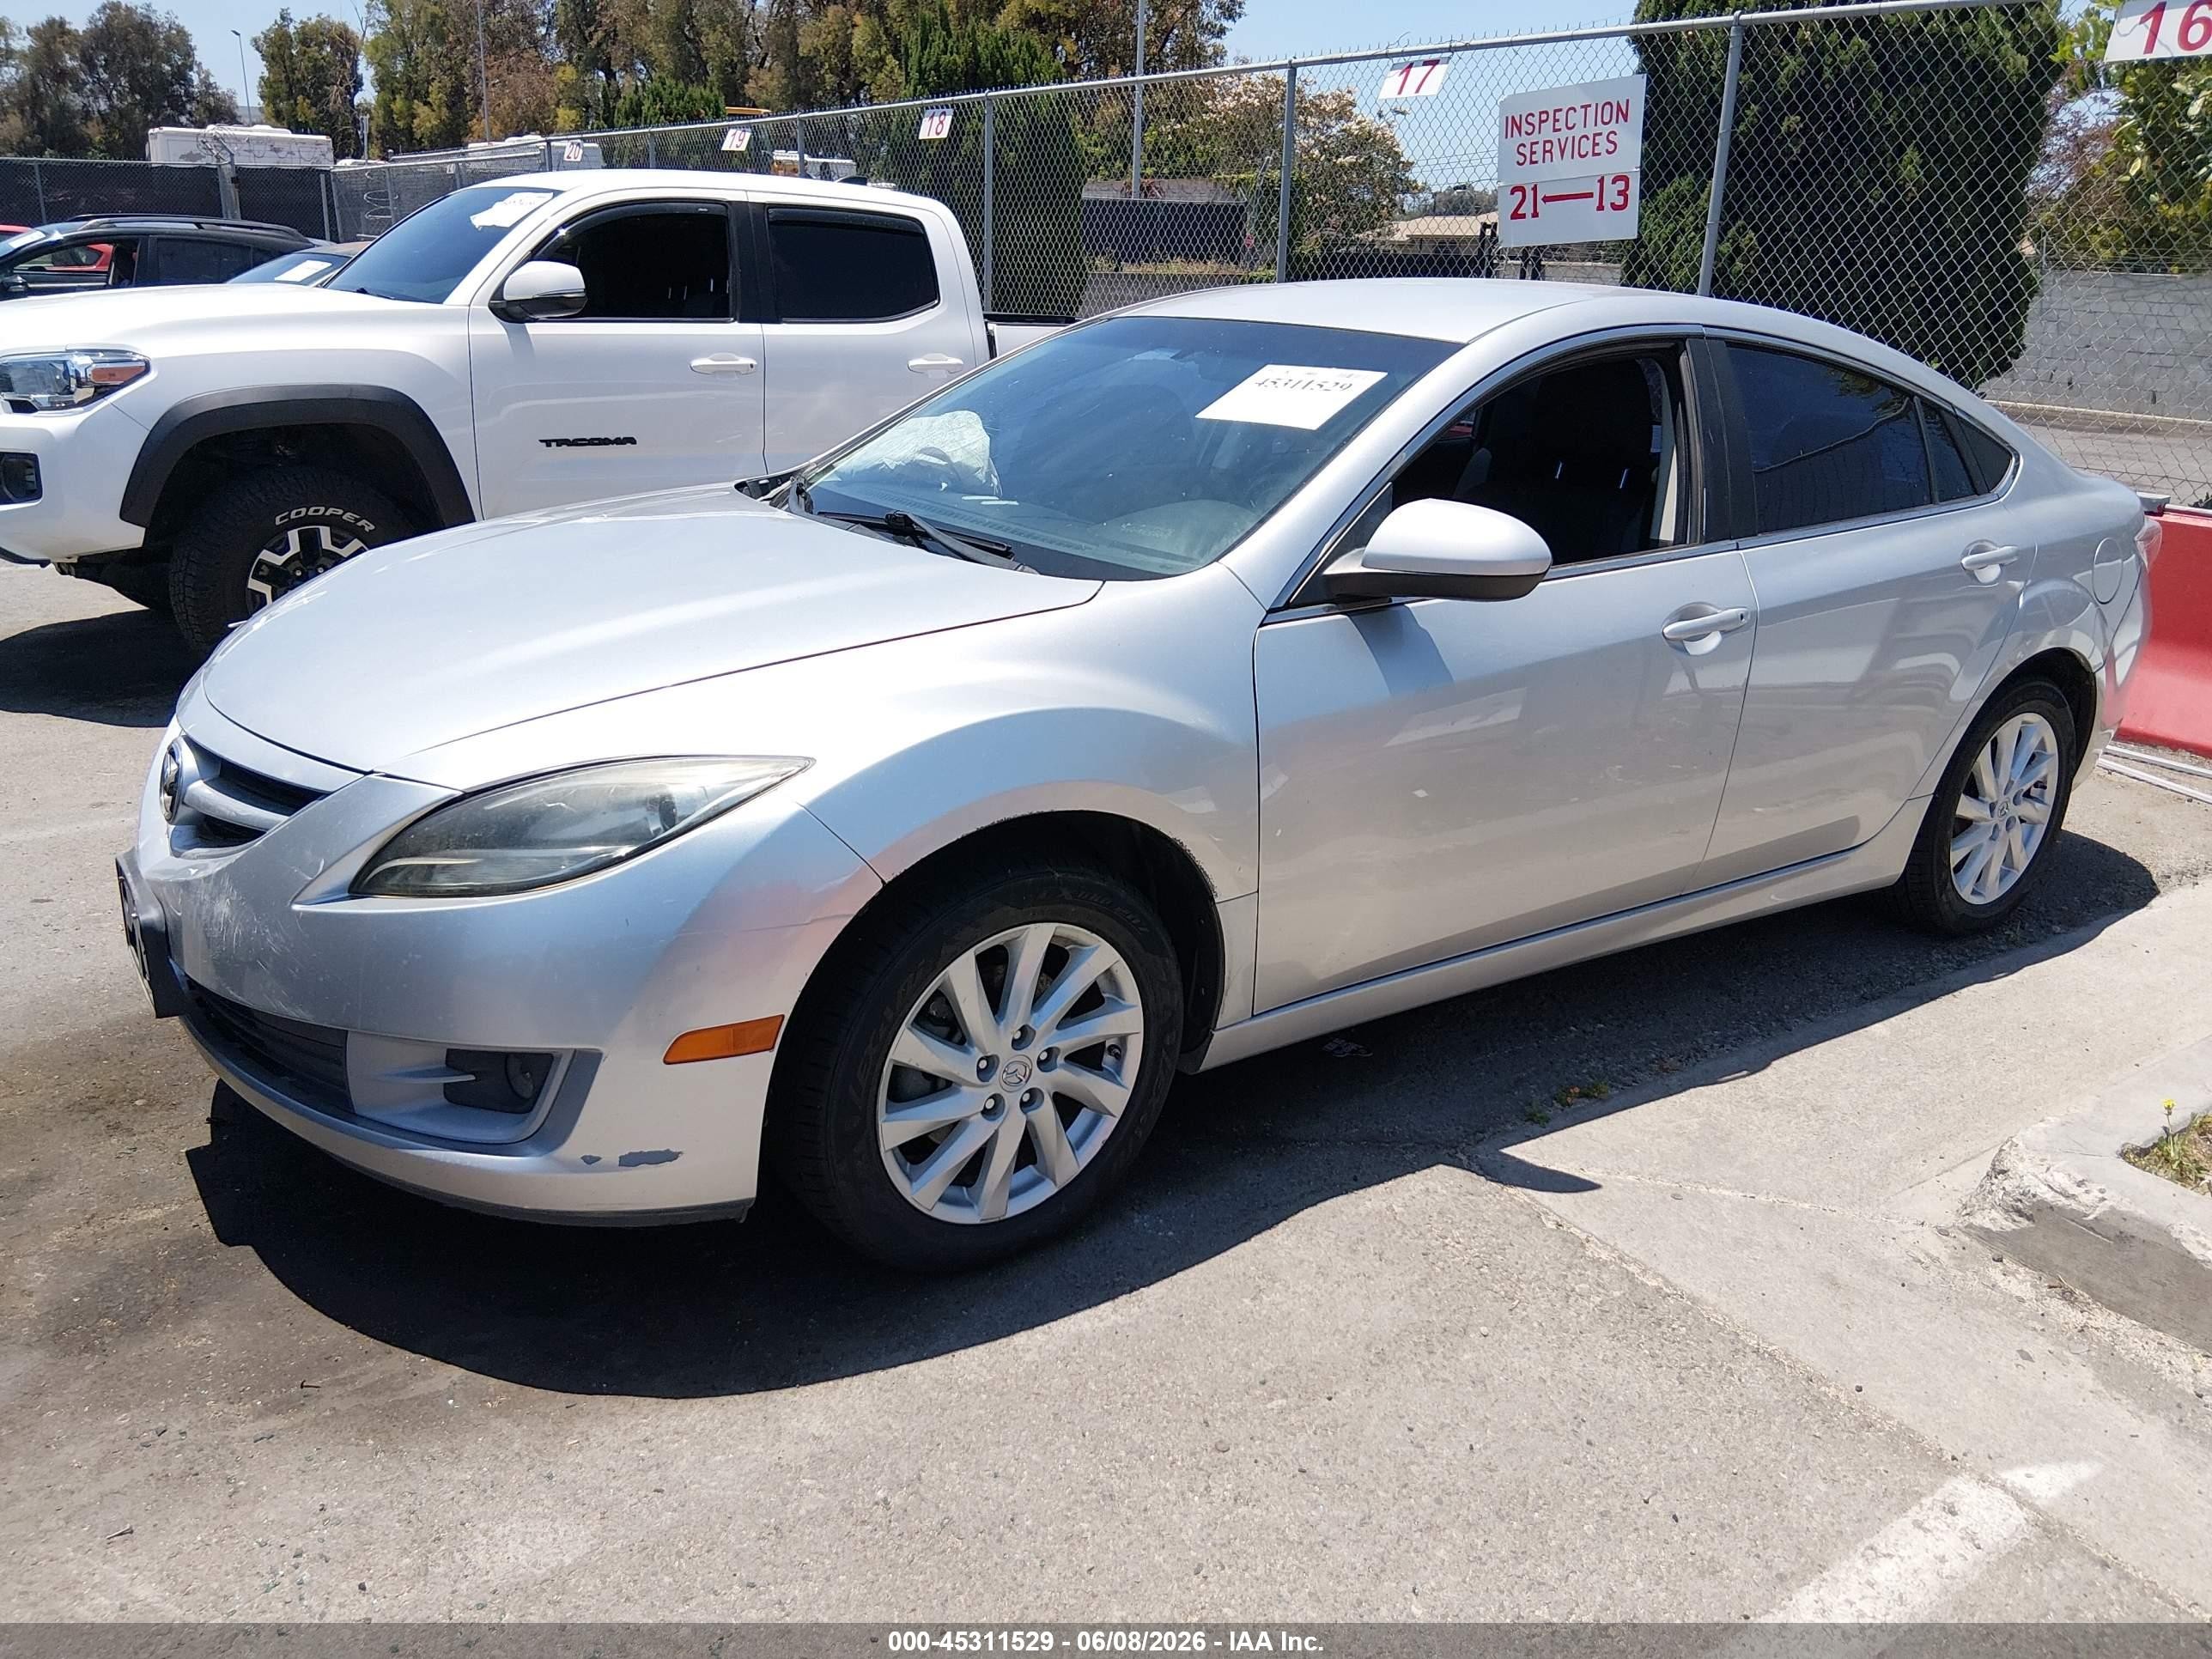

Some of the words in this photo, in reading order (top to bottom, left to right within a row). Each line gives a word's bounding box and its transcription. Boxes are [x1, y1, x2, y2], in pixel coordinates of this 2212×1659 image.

[2139, 0, 2212, 55] 16
[1398, 59, 1441, 95] 17
[927, 111, 947, 137] 18
[1504, 99, 1630, 139] INSPECTION
[566, 141, 581, 160] 20
[729, 129, 746, 149] 19
[1516, 131, 1618, 167] SERVICES
[1510, 184, 1540, 220] 21
[1595, 174, 1631, 211] 13
[538, 436, 637, 447] TACOMA
[275, 506, 376, 532] COOPER
